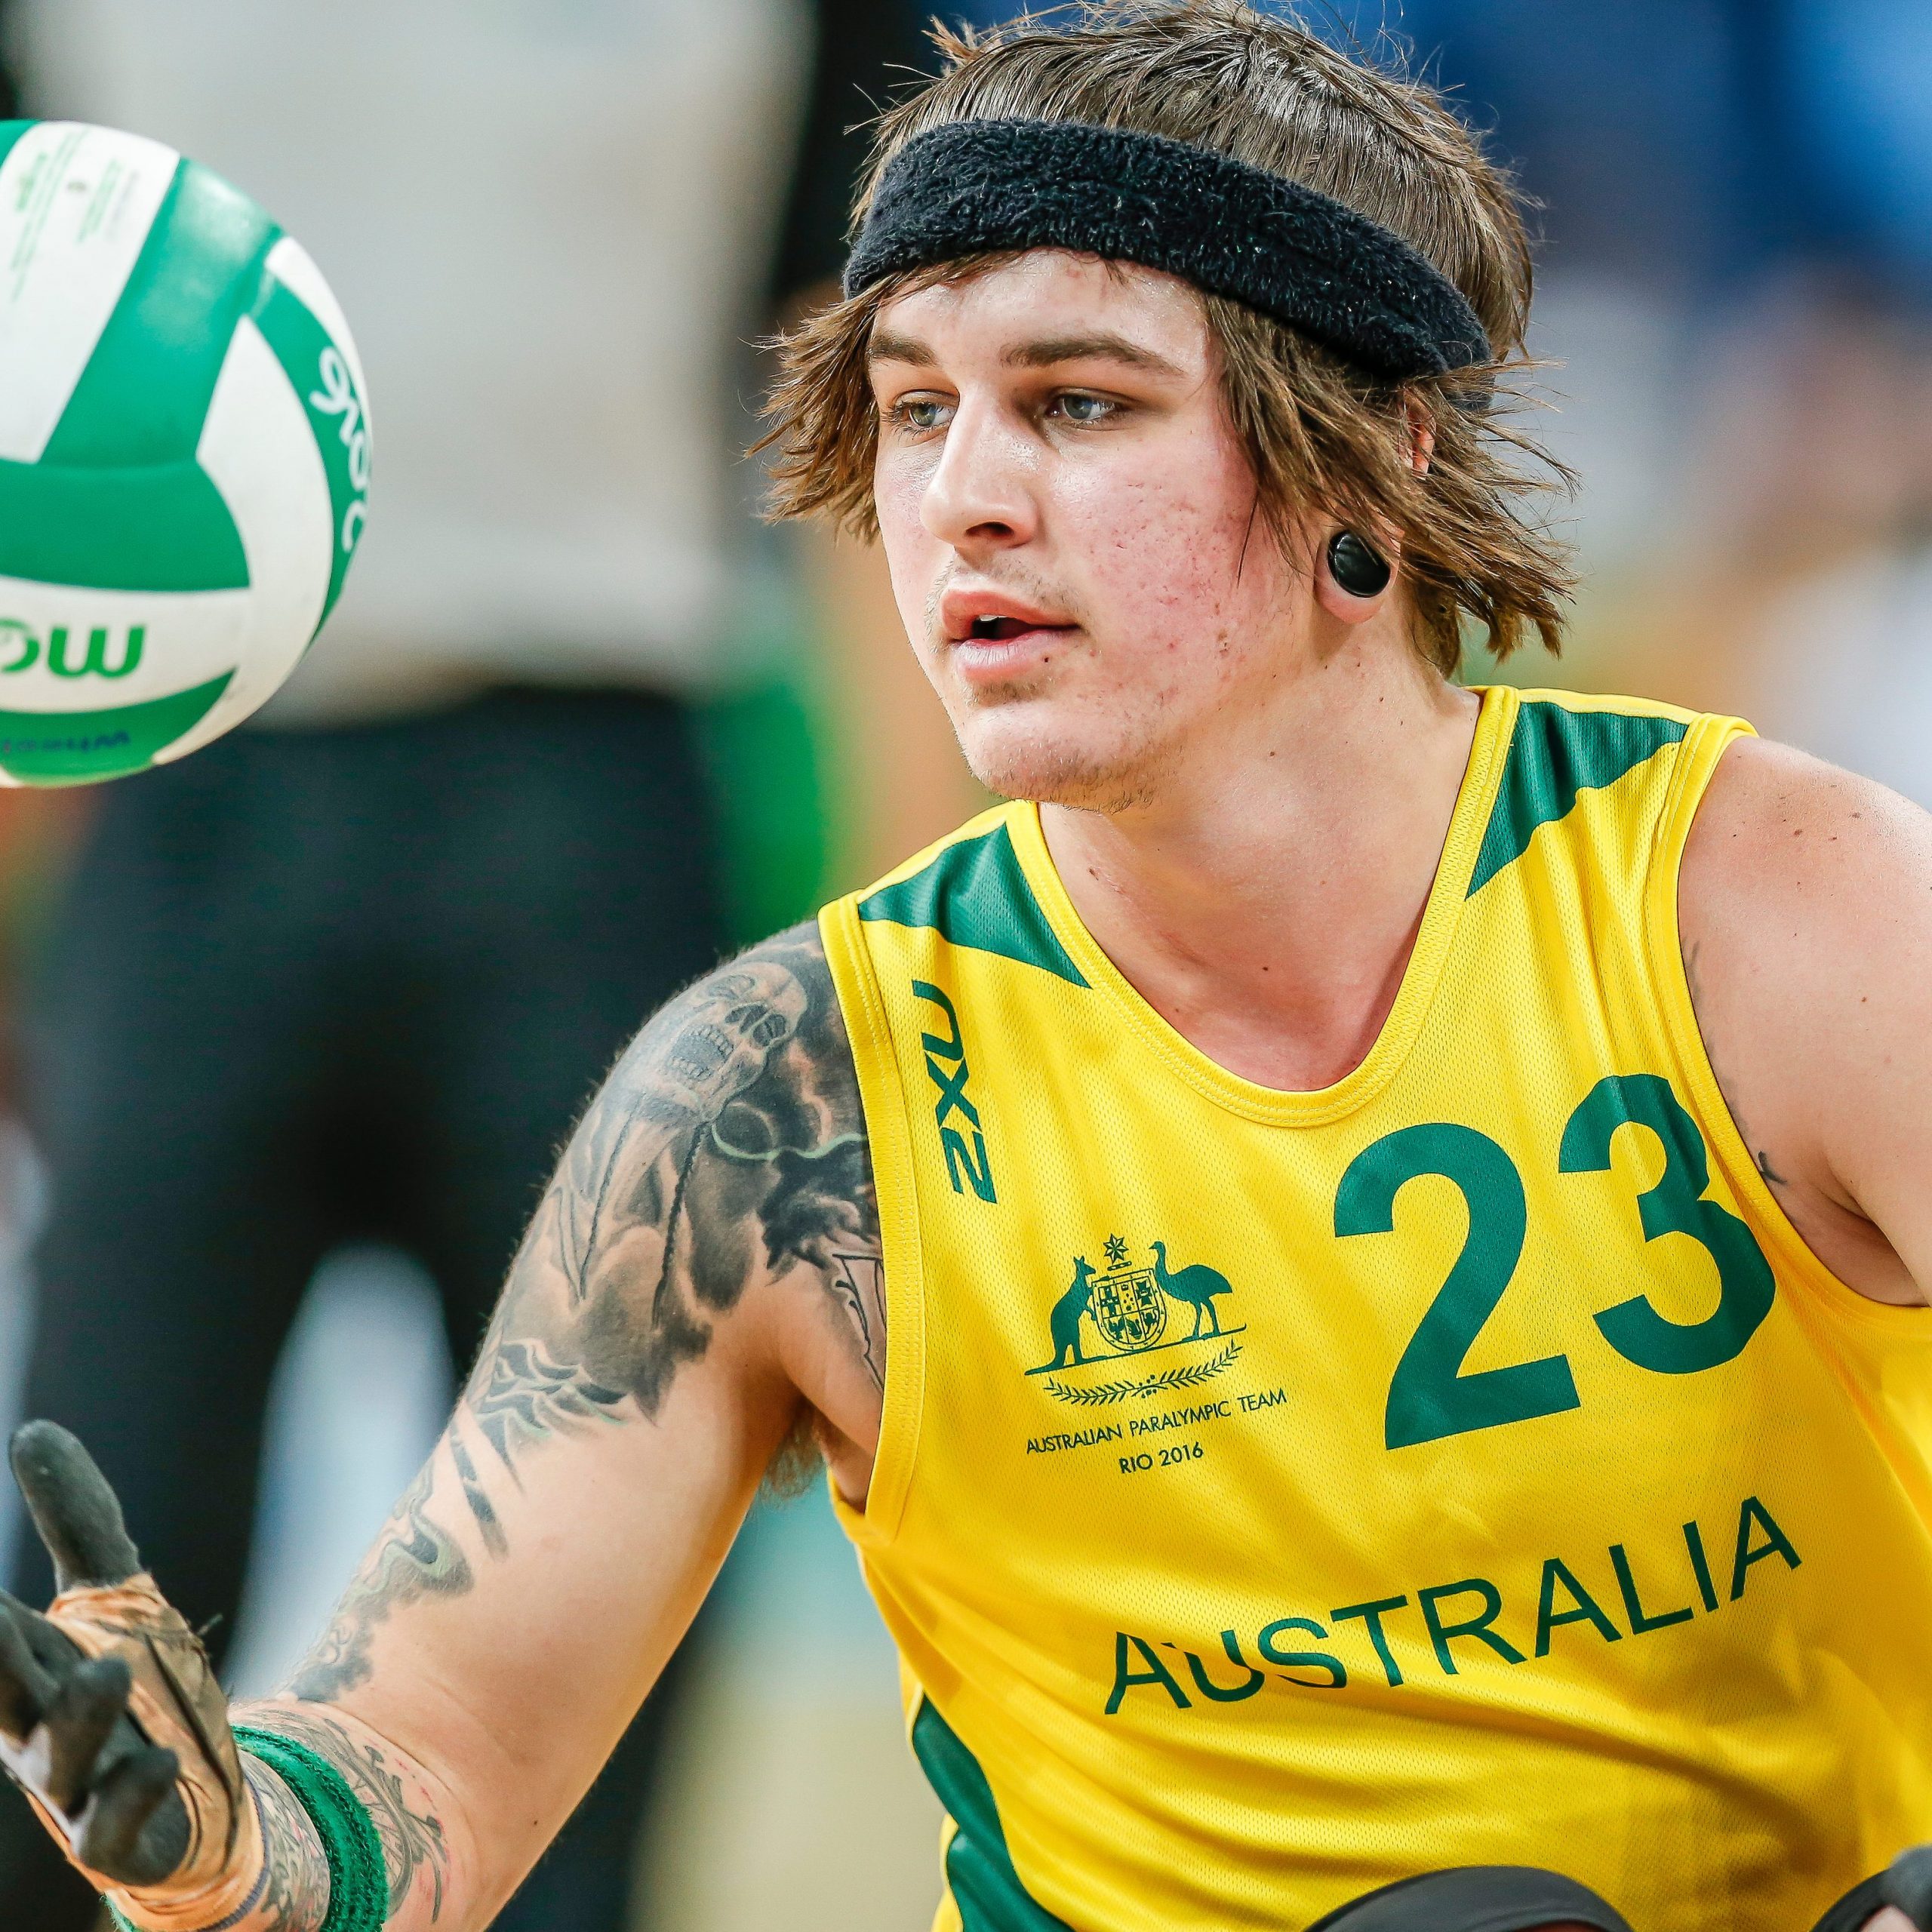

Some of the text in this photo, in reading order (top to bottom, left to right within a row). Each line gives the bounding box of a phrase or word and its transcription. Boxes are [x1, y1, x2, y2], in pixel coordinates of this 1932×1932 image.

[912, 979, 997, 1204] 2XU
[1334, 1073, 1776, 1451] 23
[1026, 1387, 1287, 1454] AUSTRALIAN PARALYMPIC TEAM
[1118, 1441, 1204, 1474] RIO 2016
[1104, 1495, 1802, 1715] AUSTRALIA
